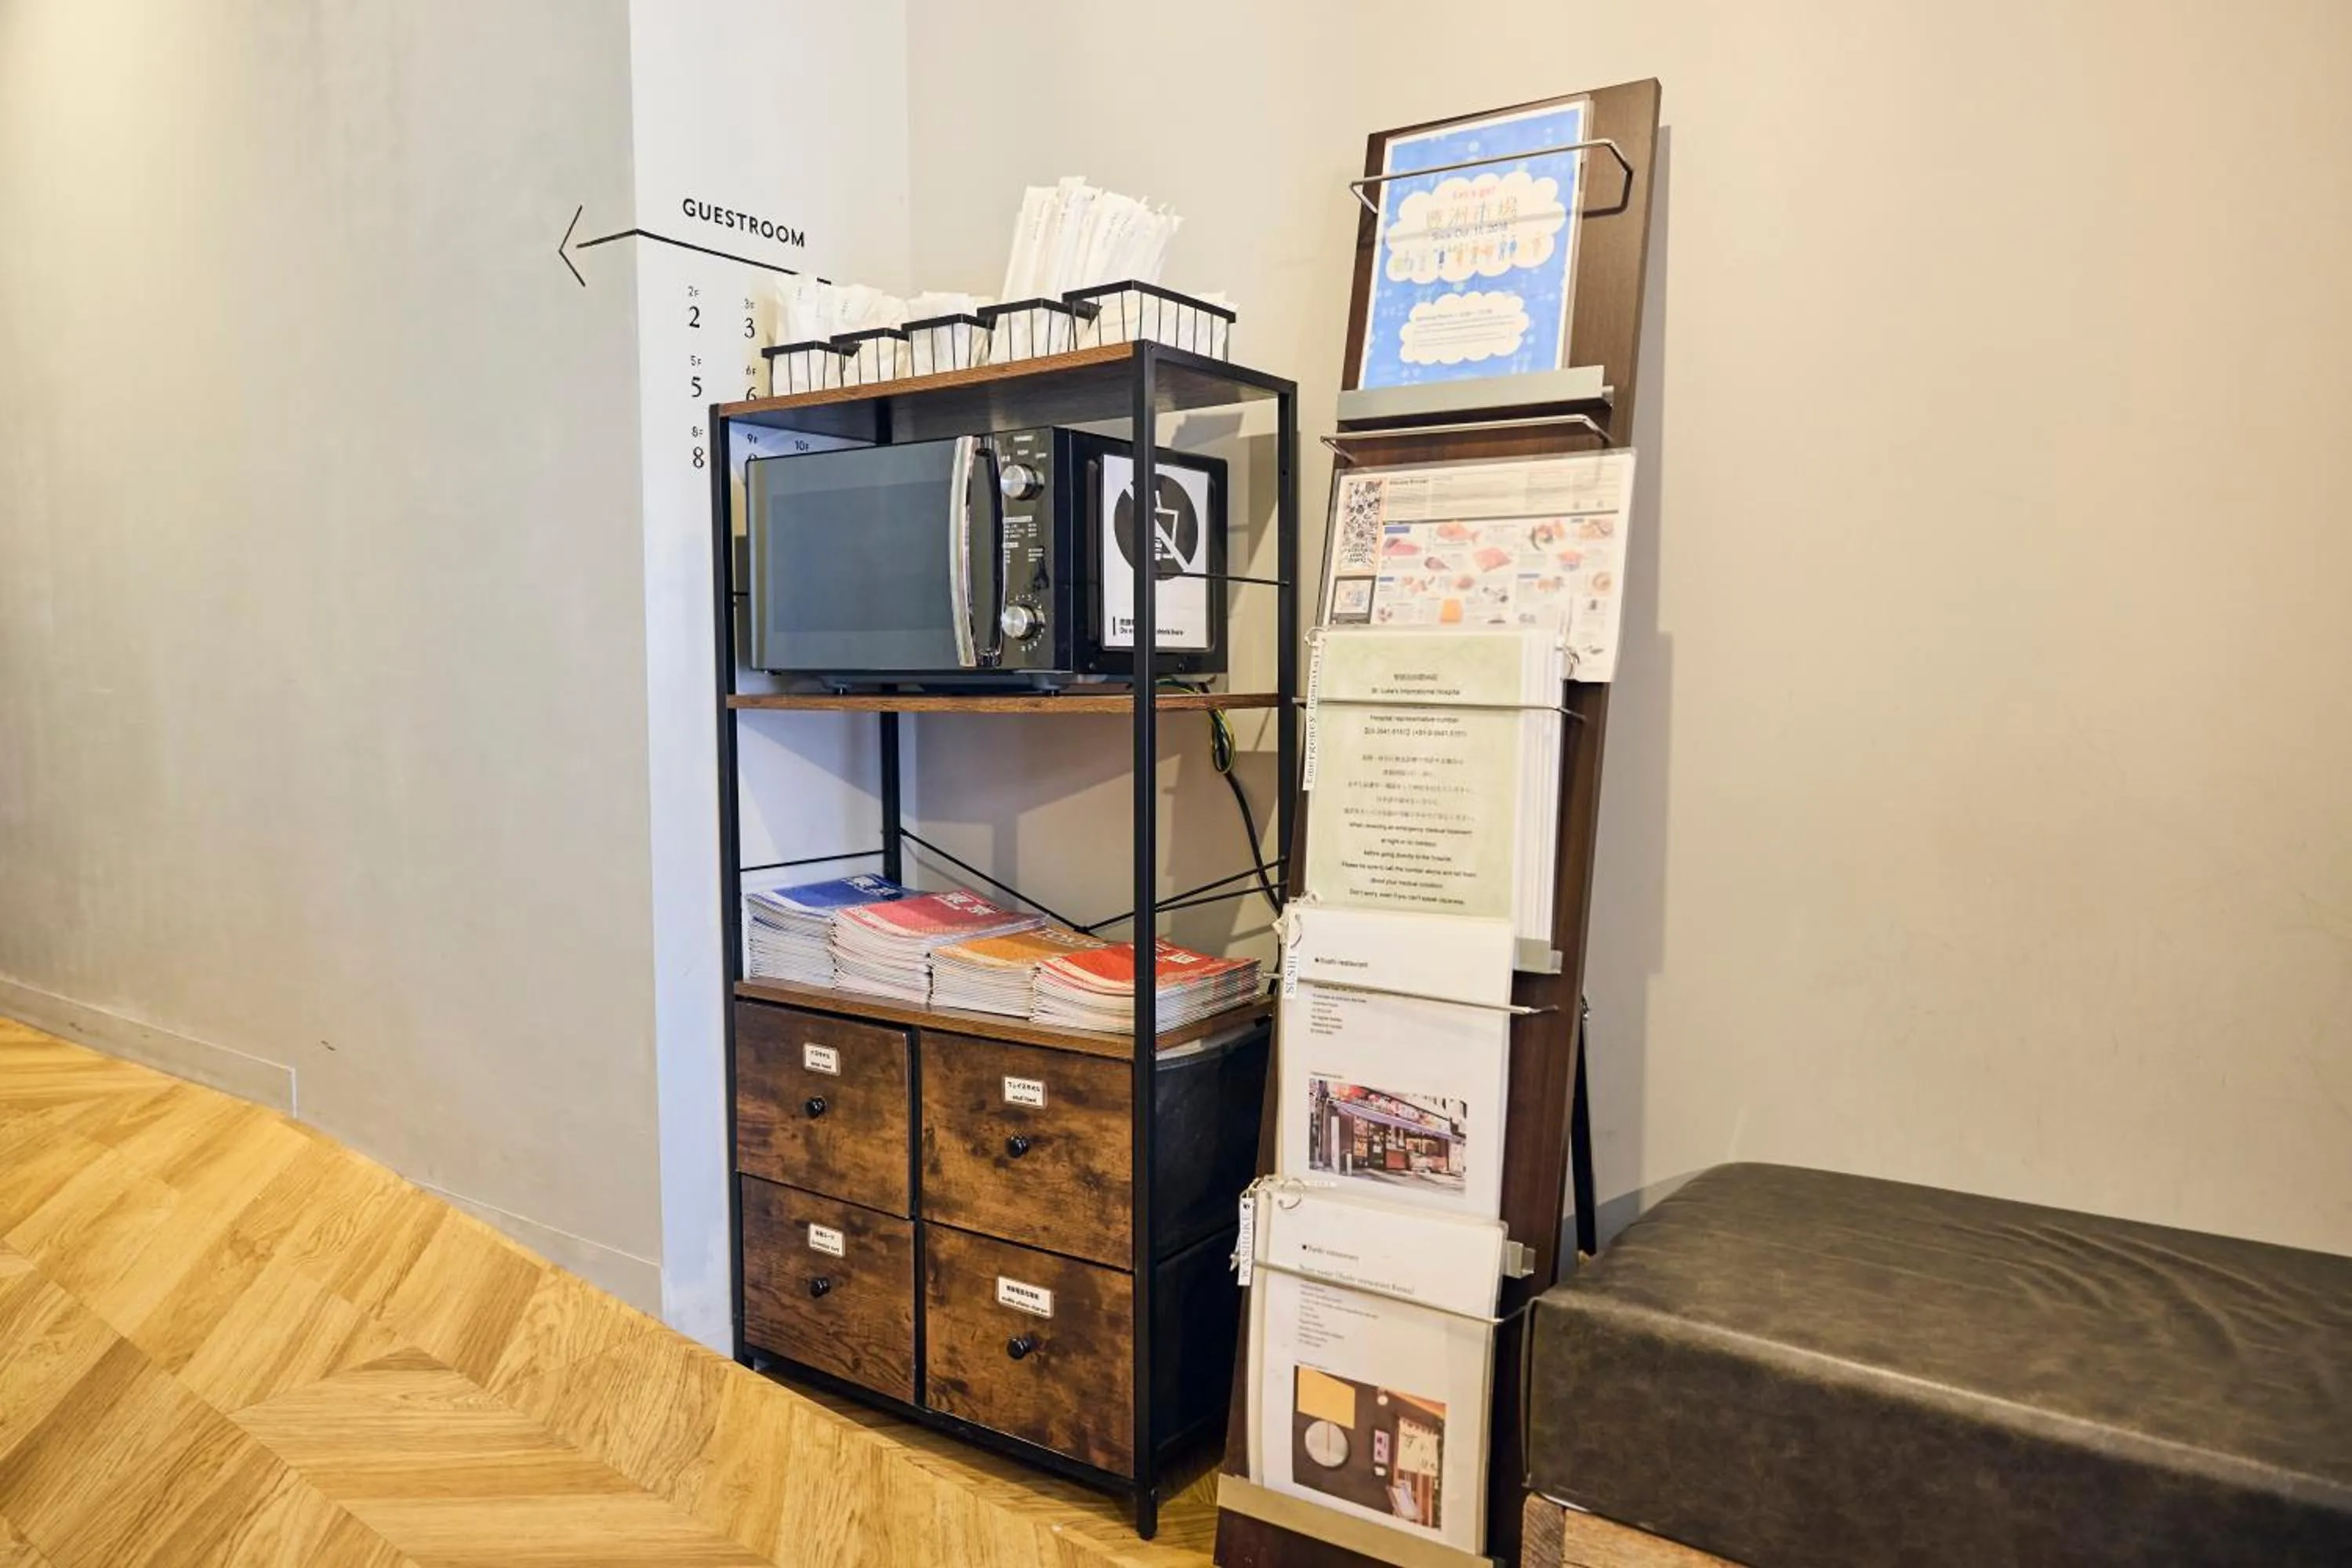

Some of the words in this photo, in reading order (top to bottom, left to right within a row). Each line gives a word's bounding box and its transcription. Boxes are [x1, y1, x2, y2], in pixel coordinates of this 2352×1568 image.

[683, 198, 804, 248] GUESTROOM
[688, 285, 699, 297] 2F
[744, 299, 755, 310] 3F
[688, 306, 701, 328] 2
[744, 317, 756, 339] 3
[690, 355, 702, 367] 5F
[746, 365, 757, 376] 6F
[691, 376, 702, 397] 5
[746, 386, 757, 401] 6
[691, 426, 703, 438] 8F
[747, 433, 758, 445] 9F
[794, 439, 810, 452] 10F
[692, 446, 705, 469] 8
[1306, 716, 1316, 784] Emergency
